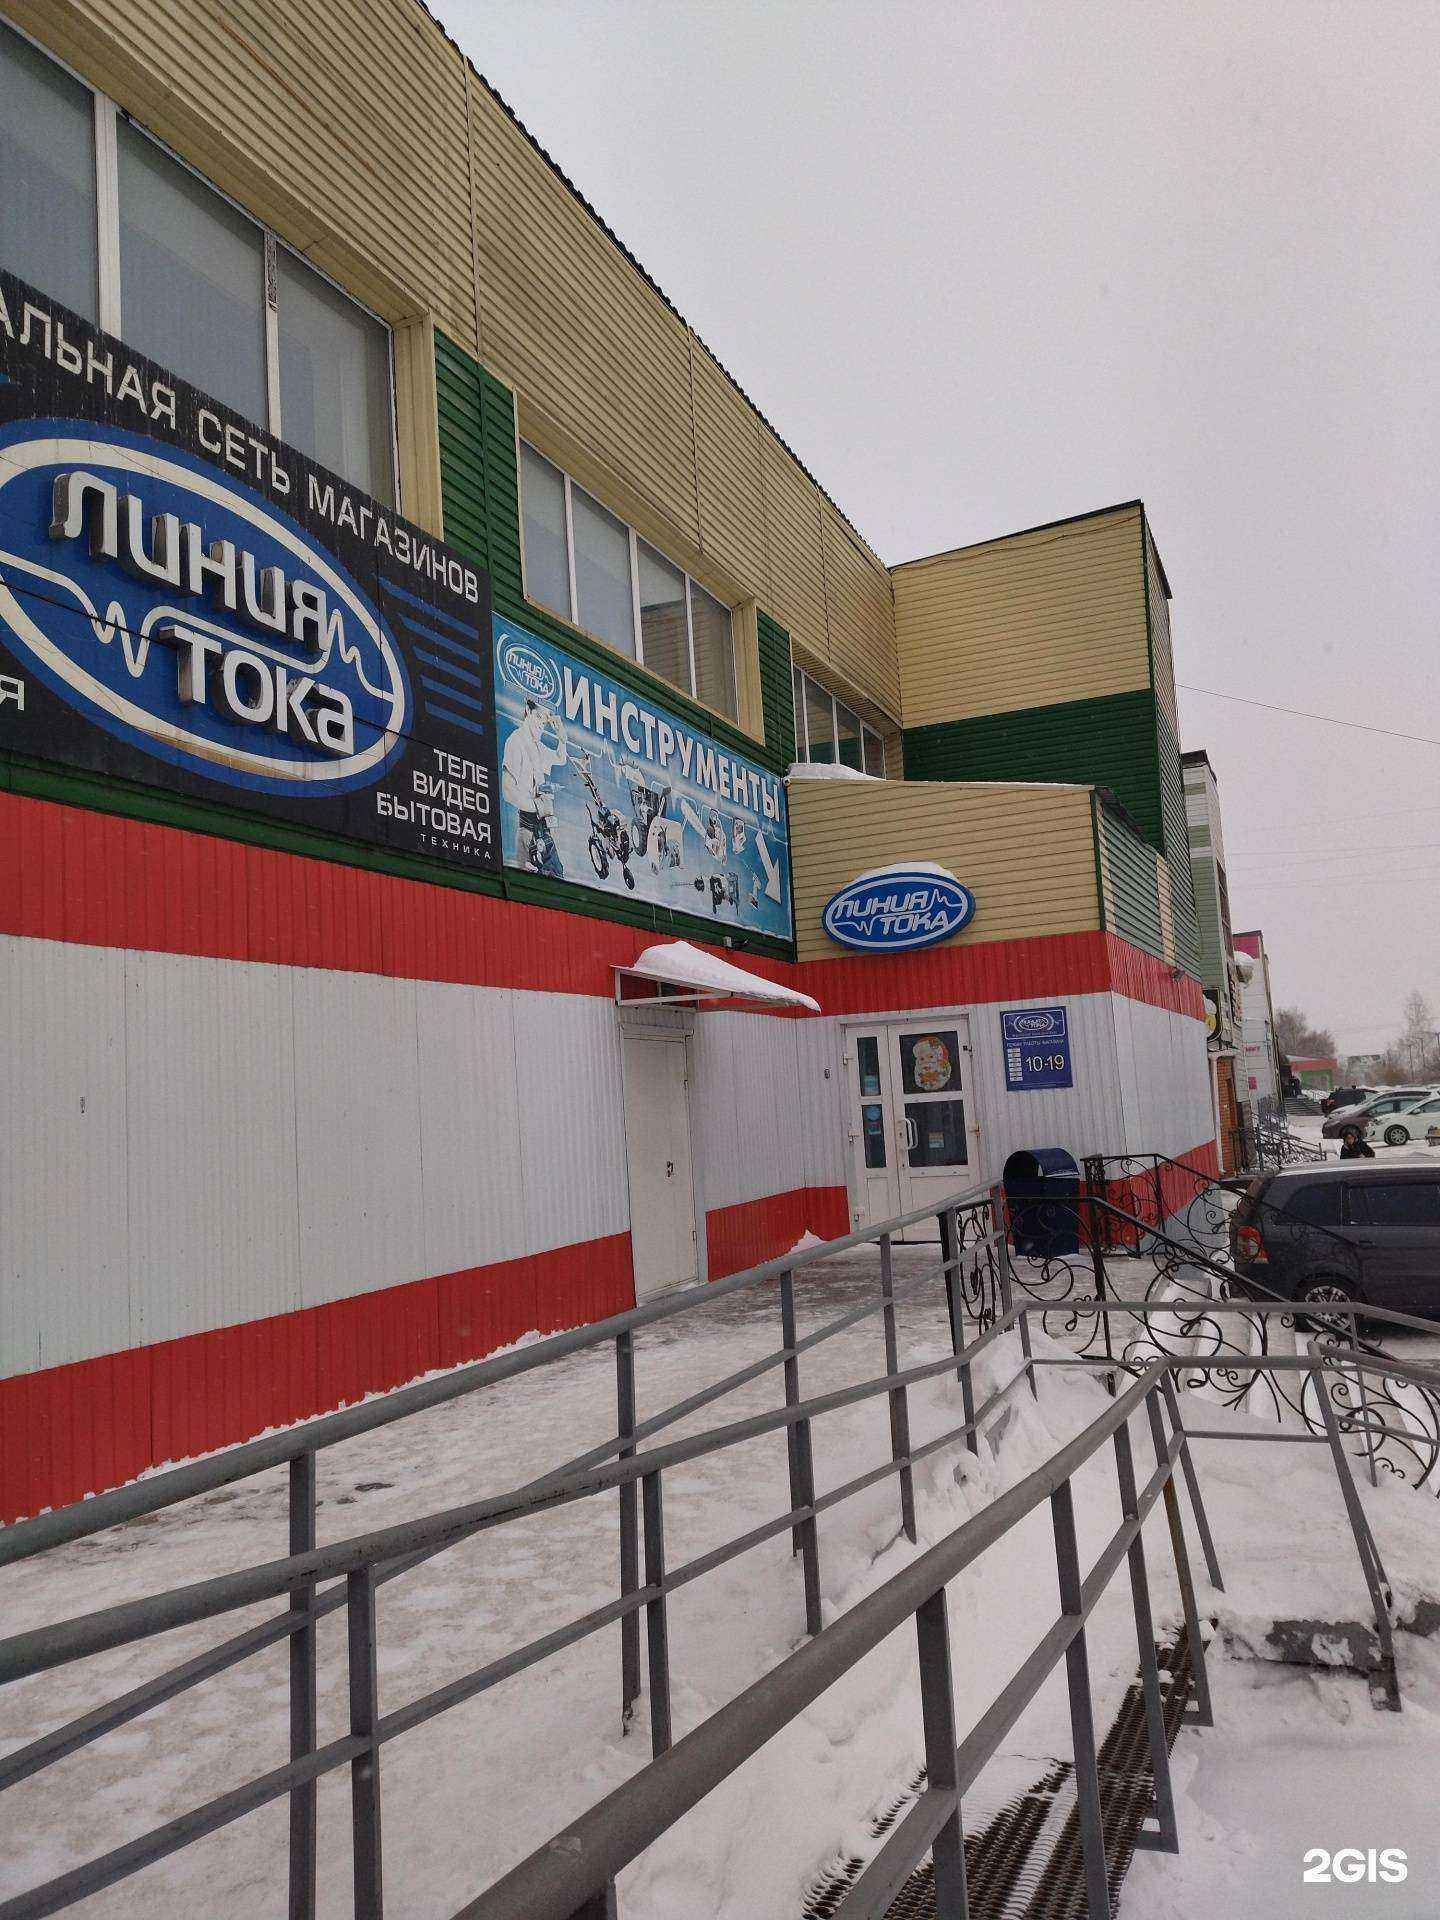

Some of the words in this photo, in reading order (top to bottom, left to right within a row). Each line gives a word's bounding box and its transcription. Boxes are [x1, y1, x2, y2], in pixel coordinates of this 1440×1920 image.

[198, 408, 291, 495] СЕТЬ
[308, 473, 479, 603] МАГАЗИНОВ
[563, 666, 781, 823] ИНСТРУМЕНТЫ
[433, 748, 489, 788] ТЕЛЕ
[412, 770, 490, 814] ВИДЕО
[376, 791, 492, 844] БЫТОВАЯ
[420, 833, 492, 860] ТЕХНИКА
[880, 910, 949, 936] ТОКА
[1025, 1054, 1065, 1072] 10-19
